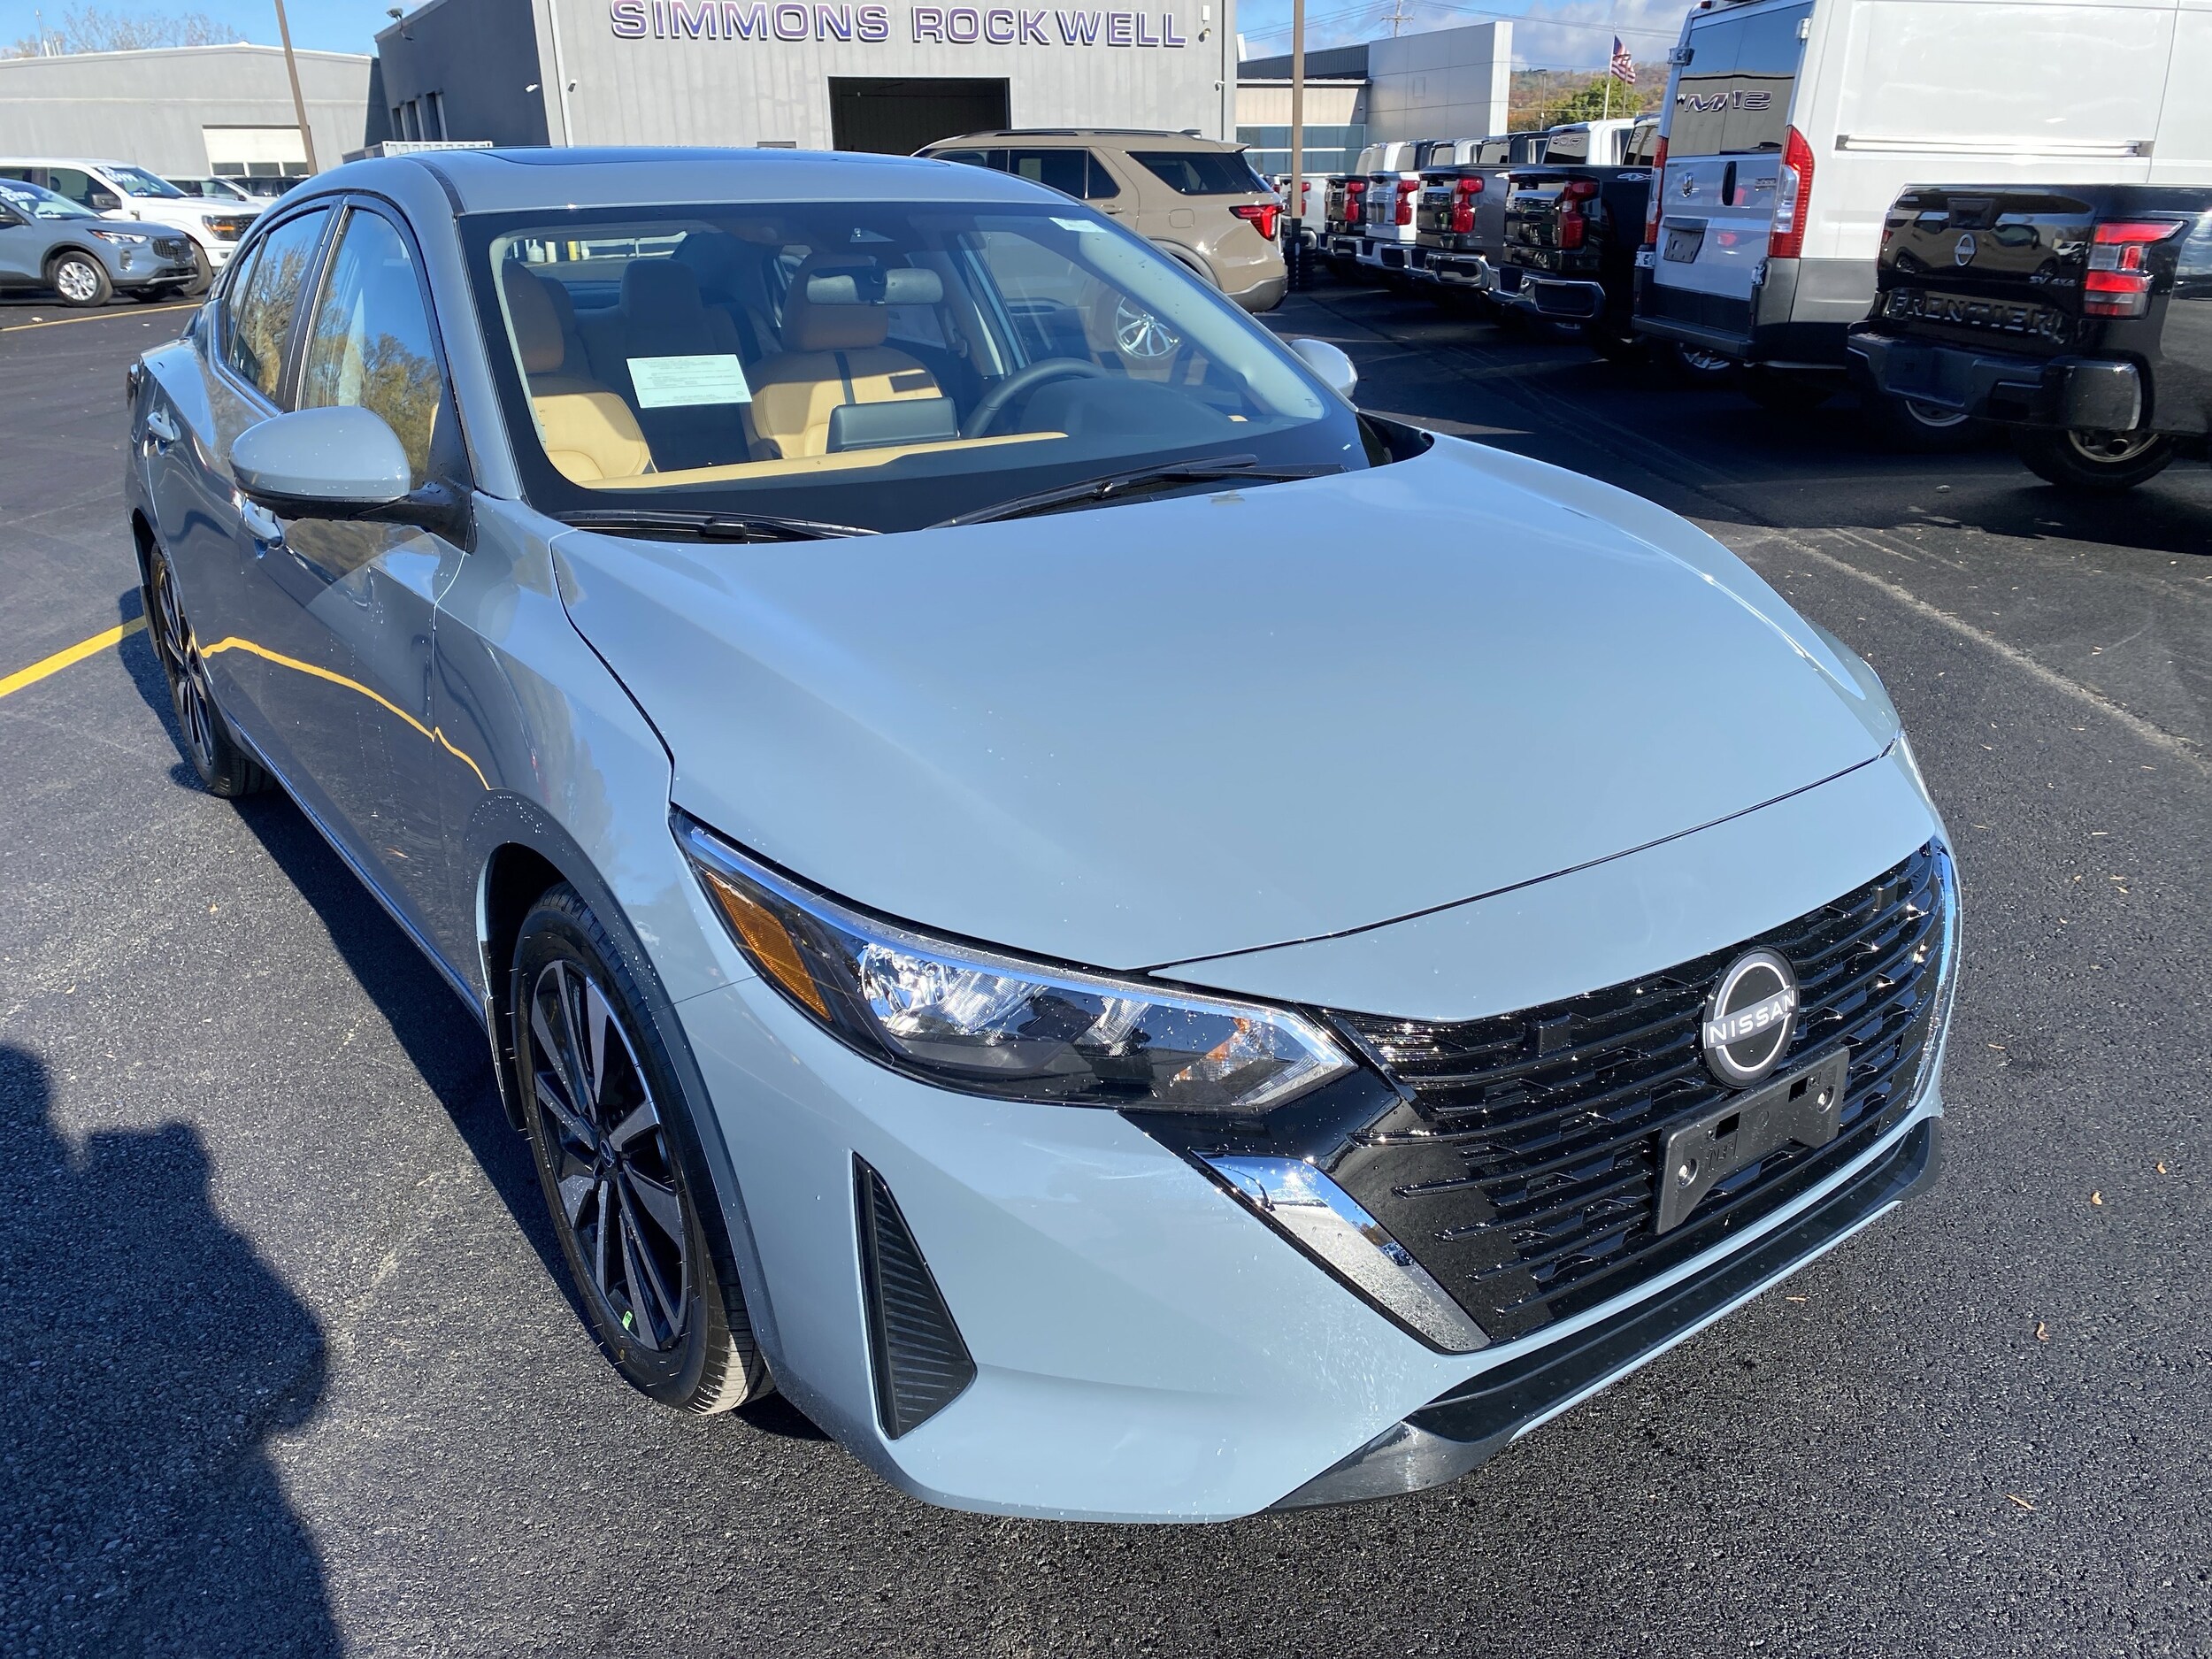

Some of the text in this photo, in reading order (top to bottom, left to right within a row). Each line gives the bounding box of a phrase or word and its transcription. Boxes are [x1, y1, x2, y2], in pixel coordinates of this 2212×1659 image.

[611, 0, 1187, 46] SIMMONS ROCKWELL
[1709, 990, 1795, 1043] NISSAN
